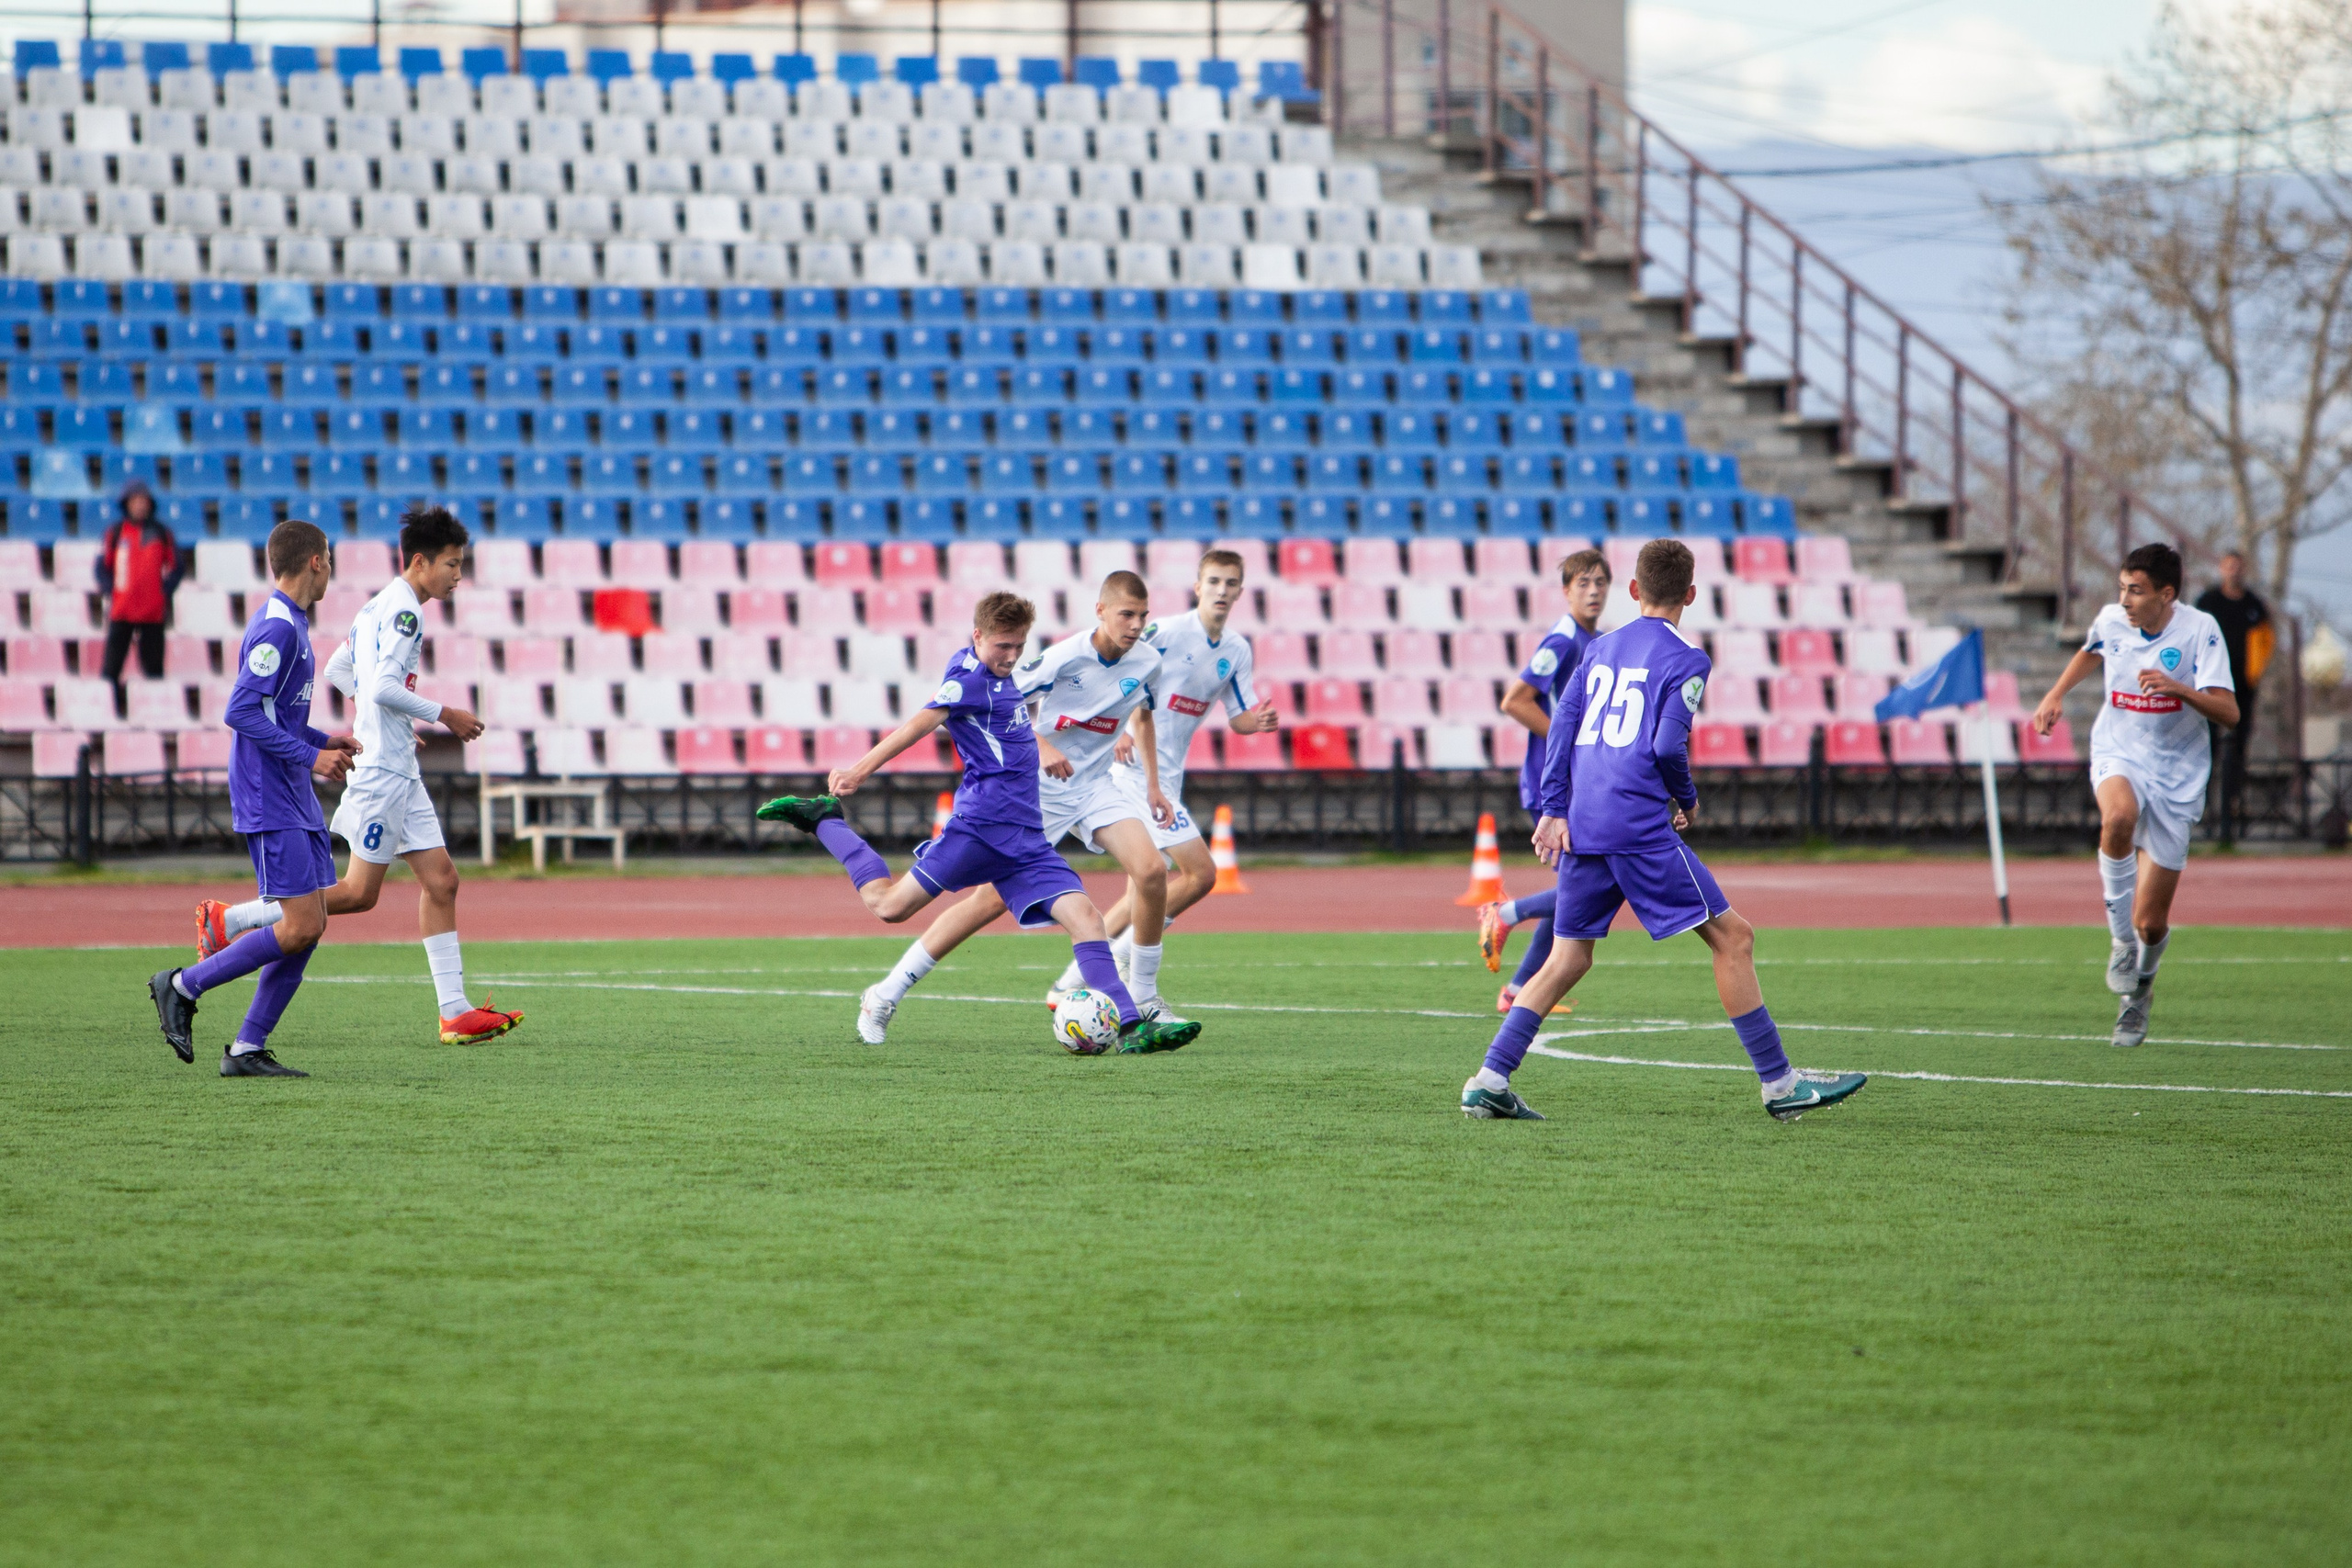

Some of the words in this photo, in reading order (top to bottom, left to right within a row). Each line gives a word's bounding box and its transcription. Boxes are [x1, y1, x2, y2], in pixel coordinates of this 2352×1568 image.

[254, 661, 270, 671] ЮФЛ
[1575, 664, 1650, 748] 25
[2117, 694, 2148, 709] Альфа
[2149, 698, 2177, 708] Банк
[1090, 717, 1114, 729] Банк
[363, 822, 384, 852] 8
